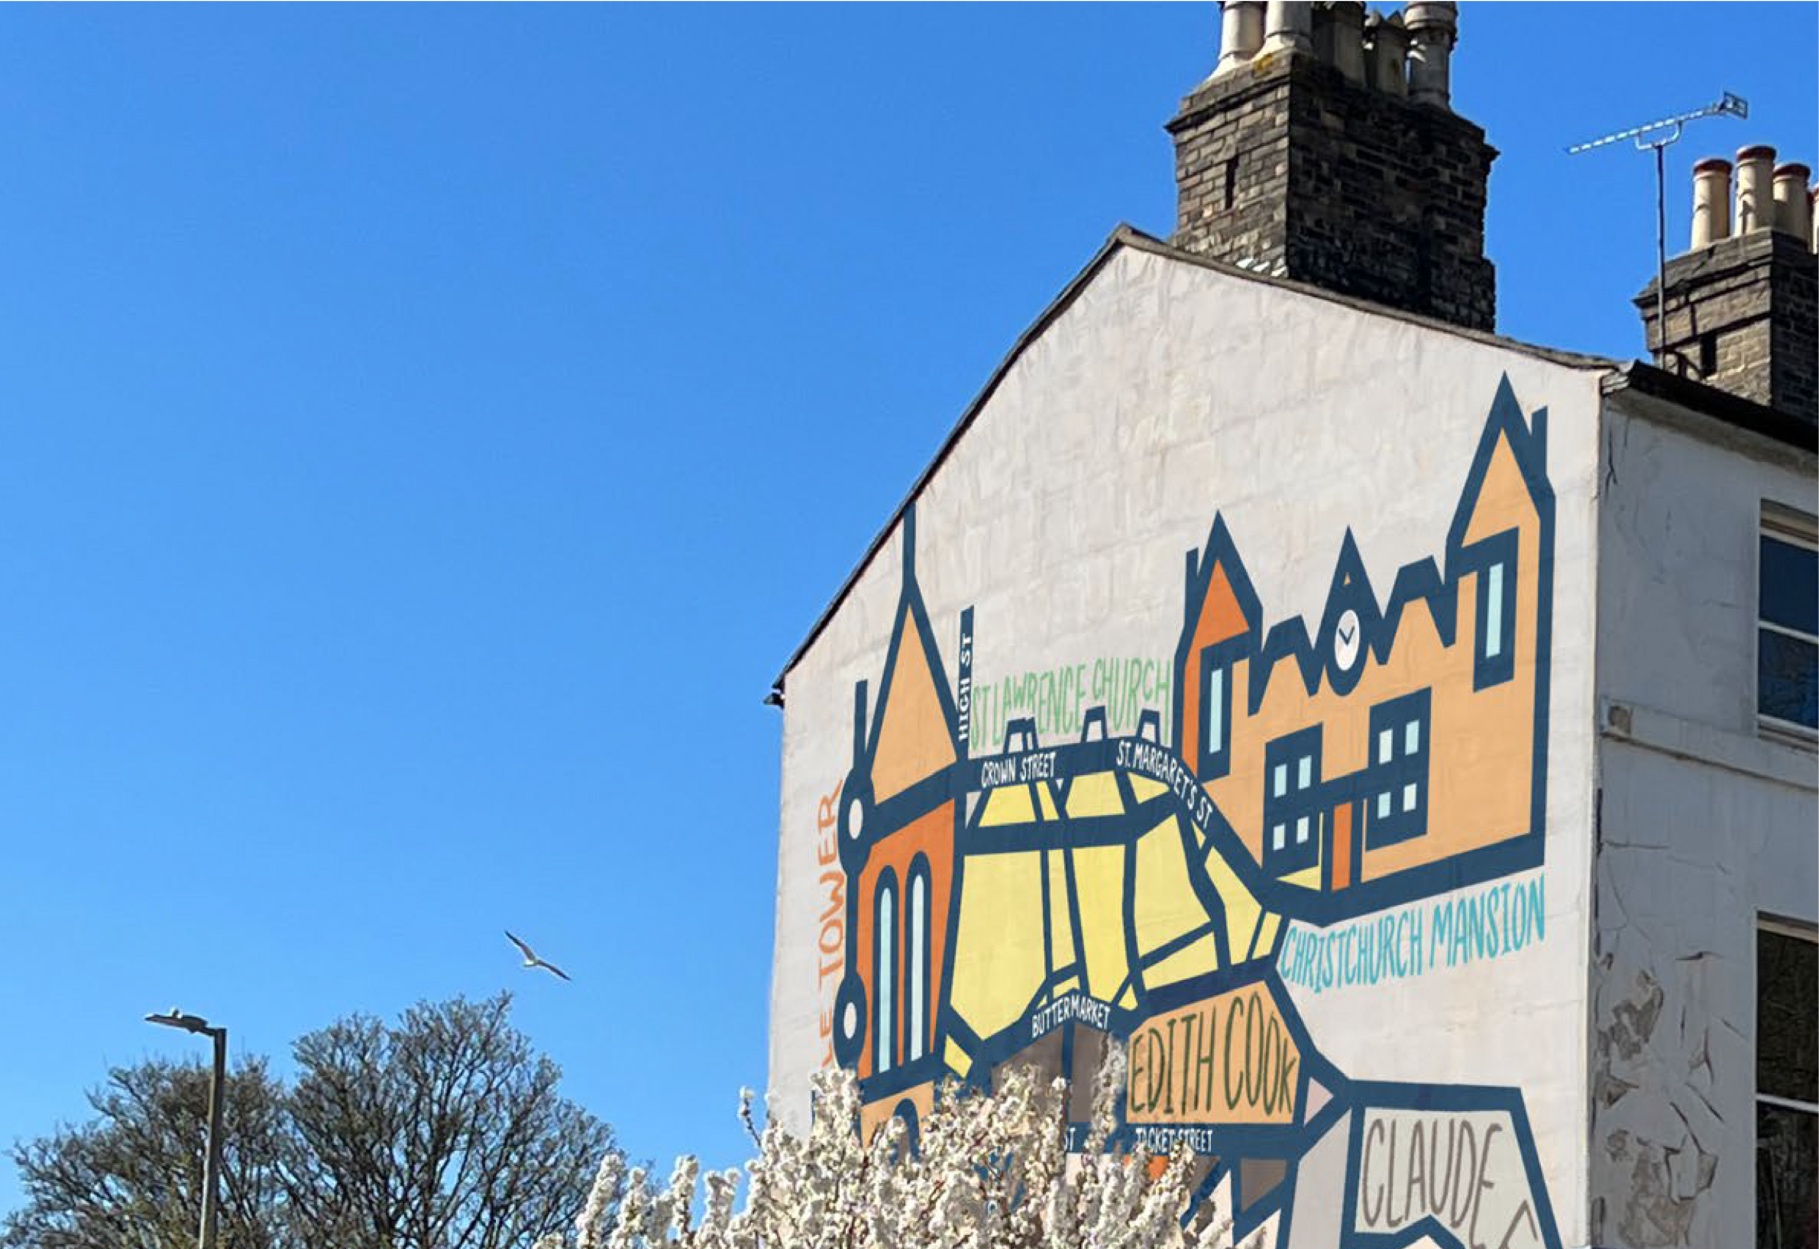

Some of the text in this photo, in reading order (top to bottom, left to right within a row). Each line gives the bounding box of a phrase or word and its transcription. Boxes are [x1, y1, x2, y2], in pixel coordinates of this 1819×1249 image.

[958, 633, 971, 742] HIGH ST
[972, 657, 1171, 751] ST LAWRENCE CHURCH
[981, 751, 1056, 788] CROWN STREET
[1133, 743, 1198, 811] MARGARET'S
[1196, 796, 1213, 829] ST
[817, 780, 845, 990] TOWER
[1281, 874, 1545, 993] CHRISTCHURCH MANSION
[1032, 995, 1111, 1039] BUTTERMARKET
[1131, 991, 1296, 1116] EDITH COOK
[1178, 1128, 1213, 1152] STREET
